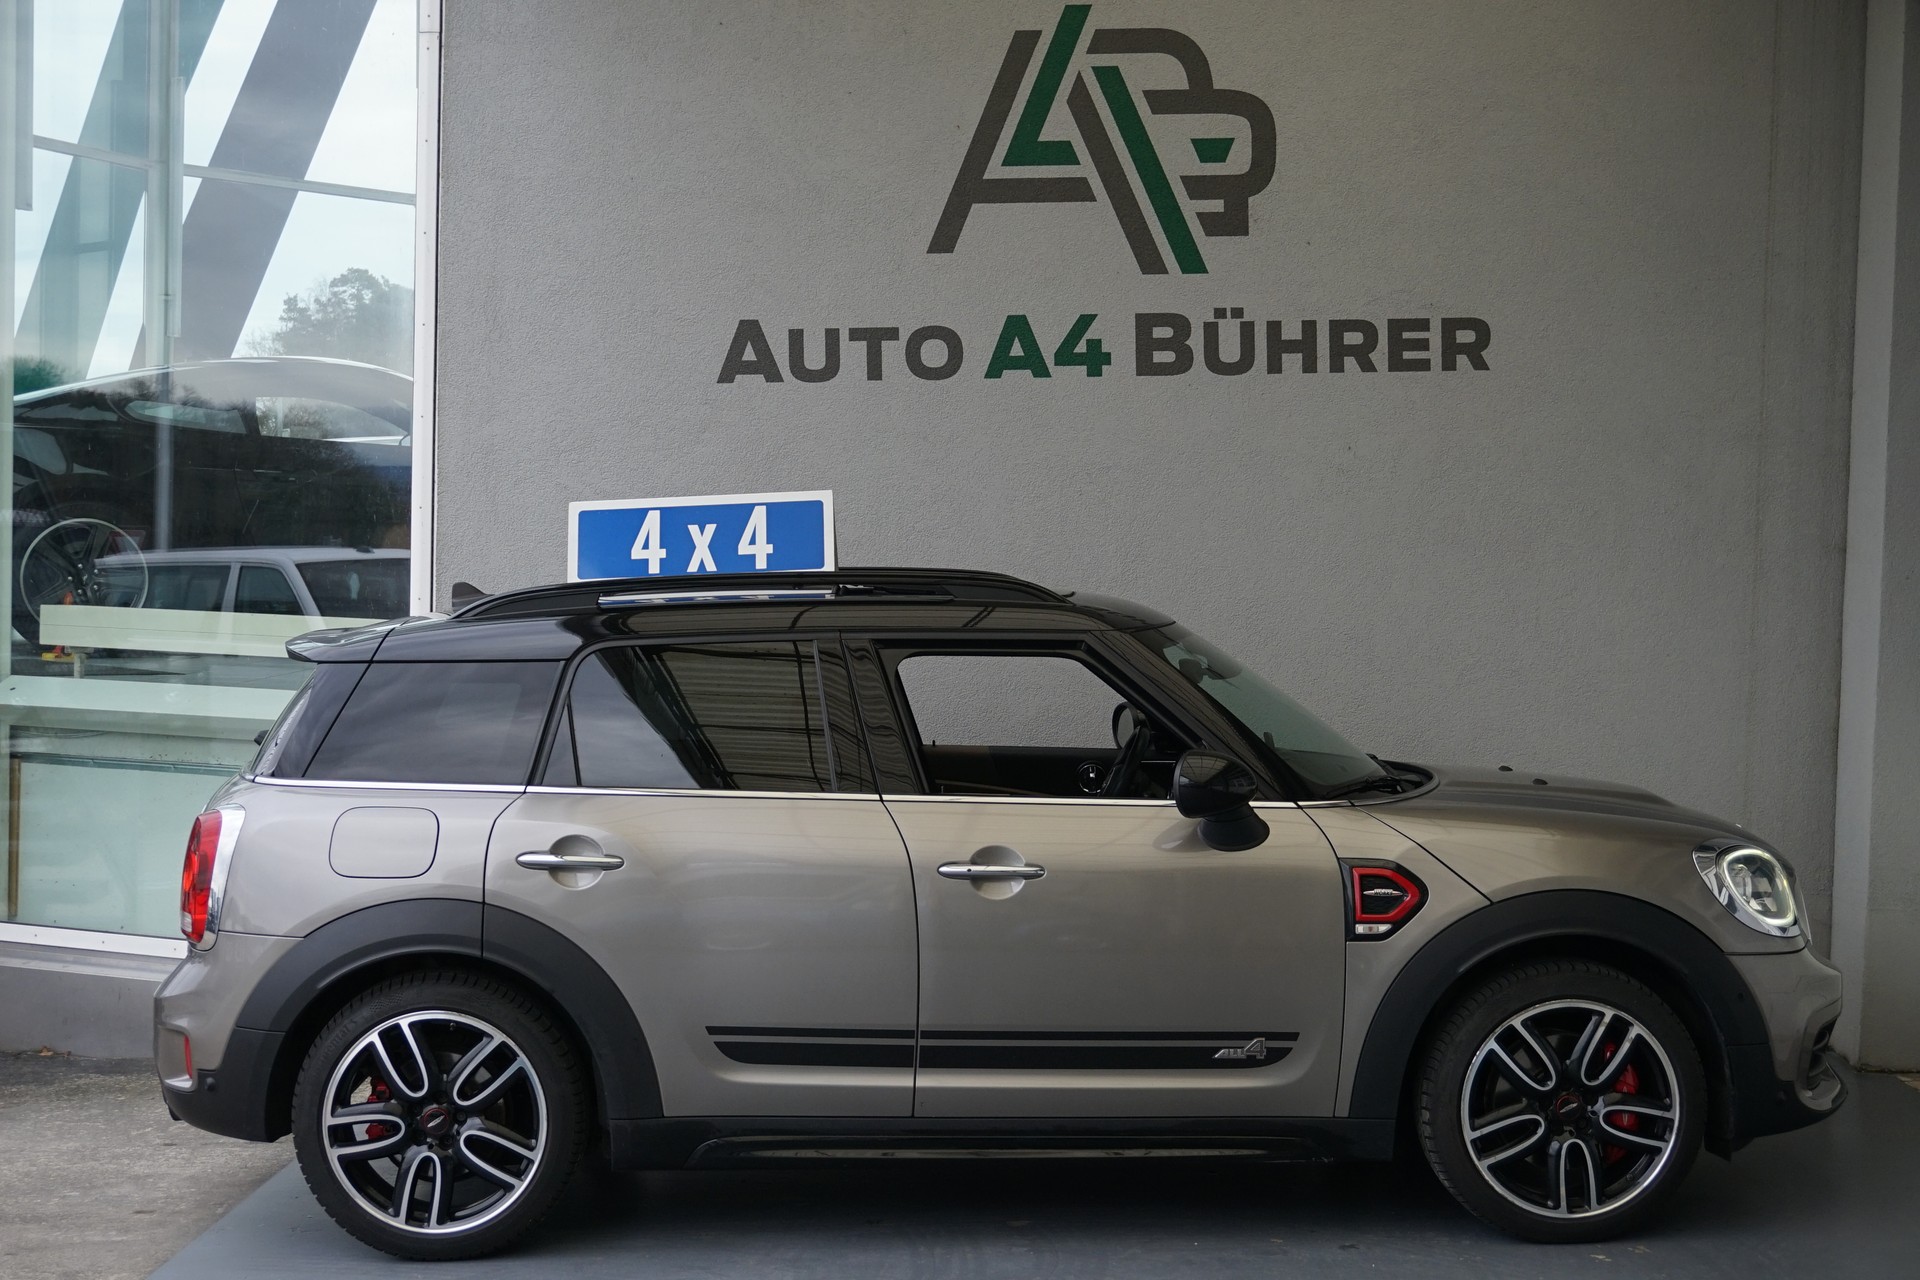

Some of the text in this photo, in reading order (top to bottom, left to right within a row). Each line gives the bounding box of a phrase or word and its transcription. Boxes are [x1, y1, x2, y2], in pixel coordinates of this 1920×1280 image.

[716, 307, 1491, 384] AUTO A4 BÜHRER
